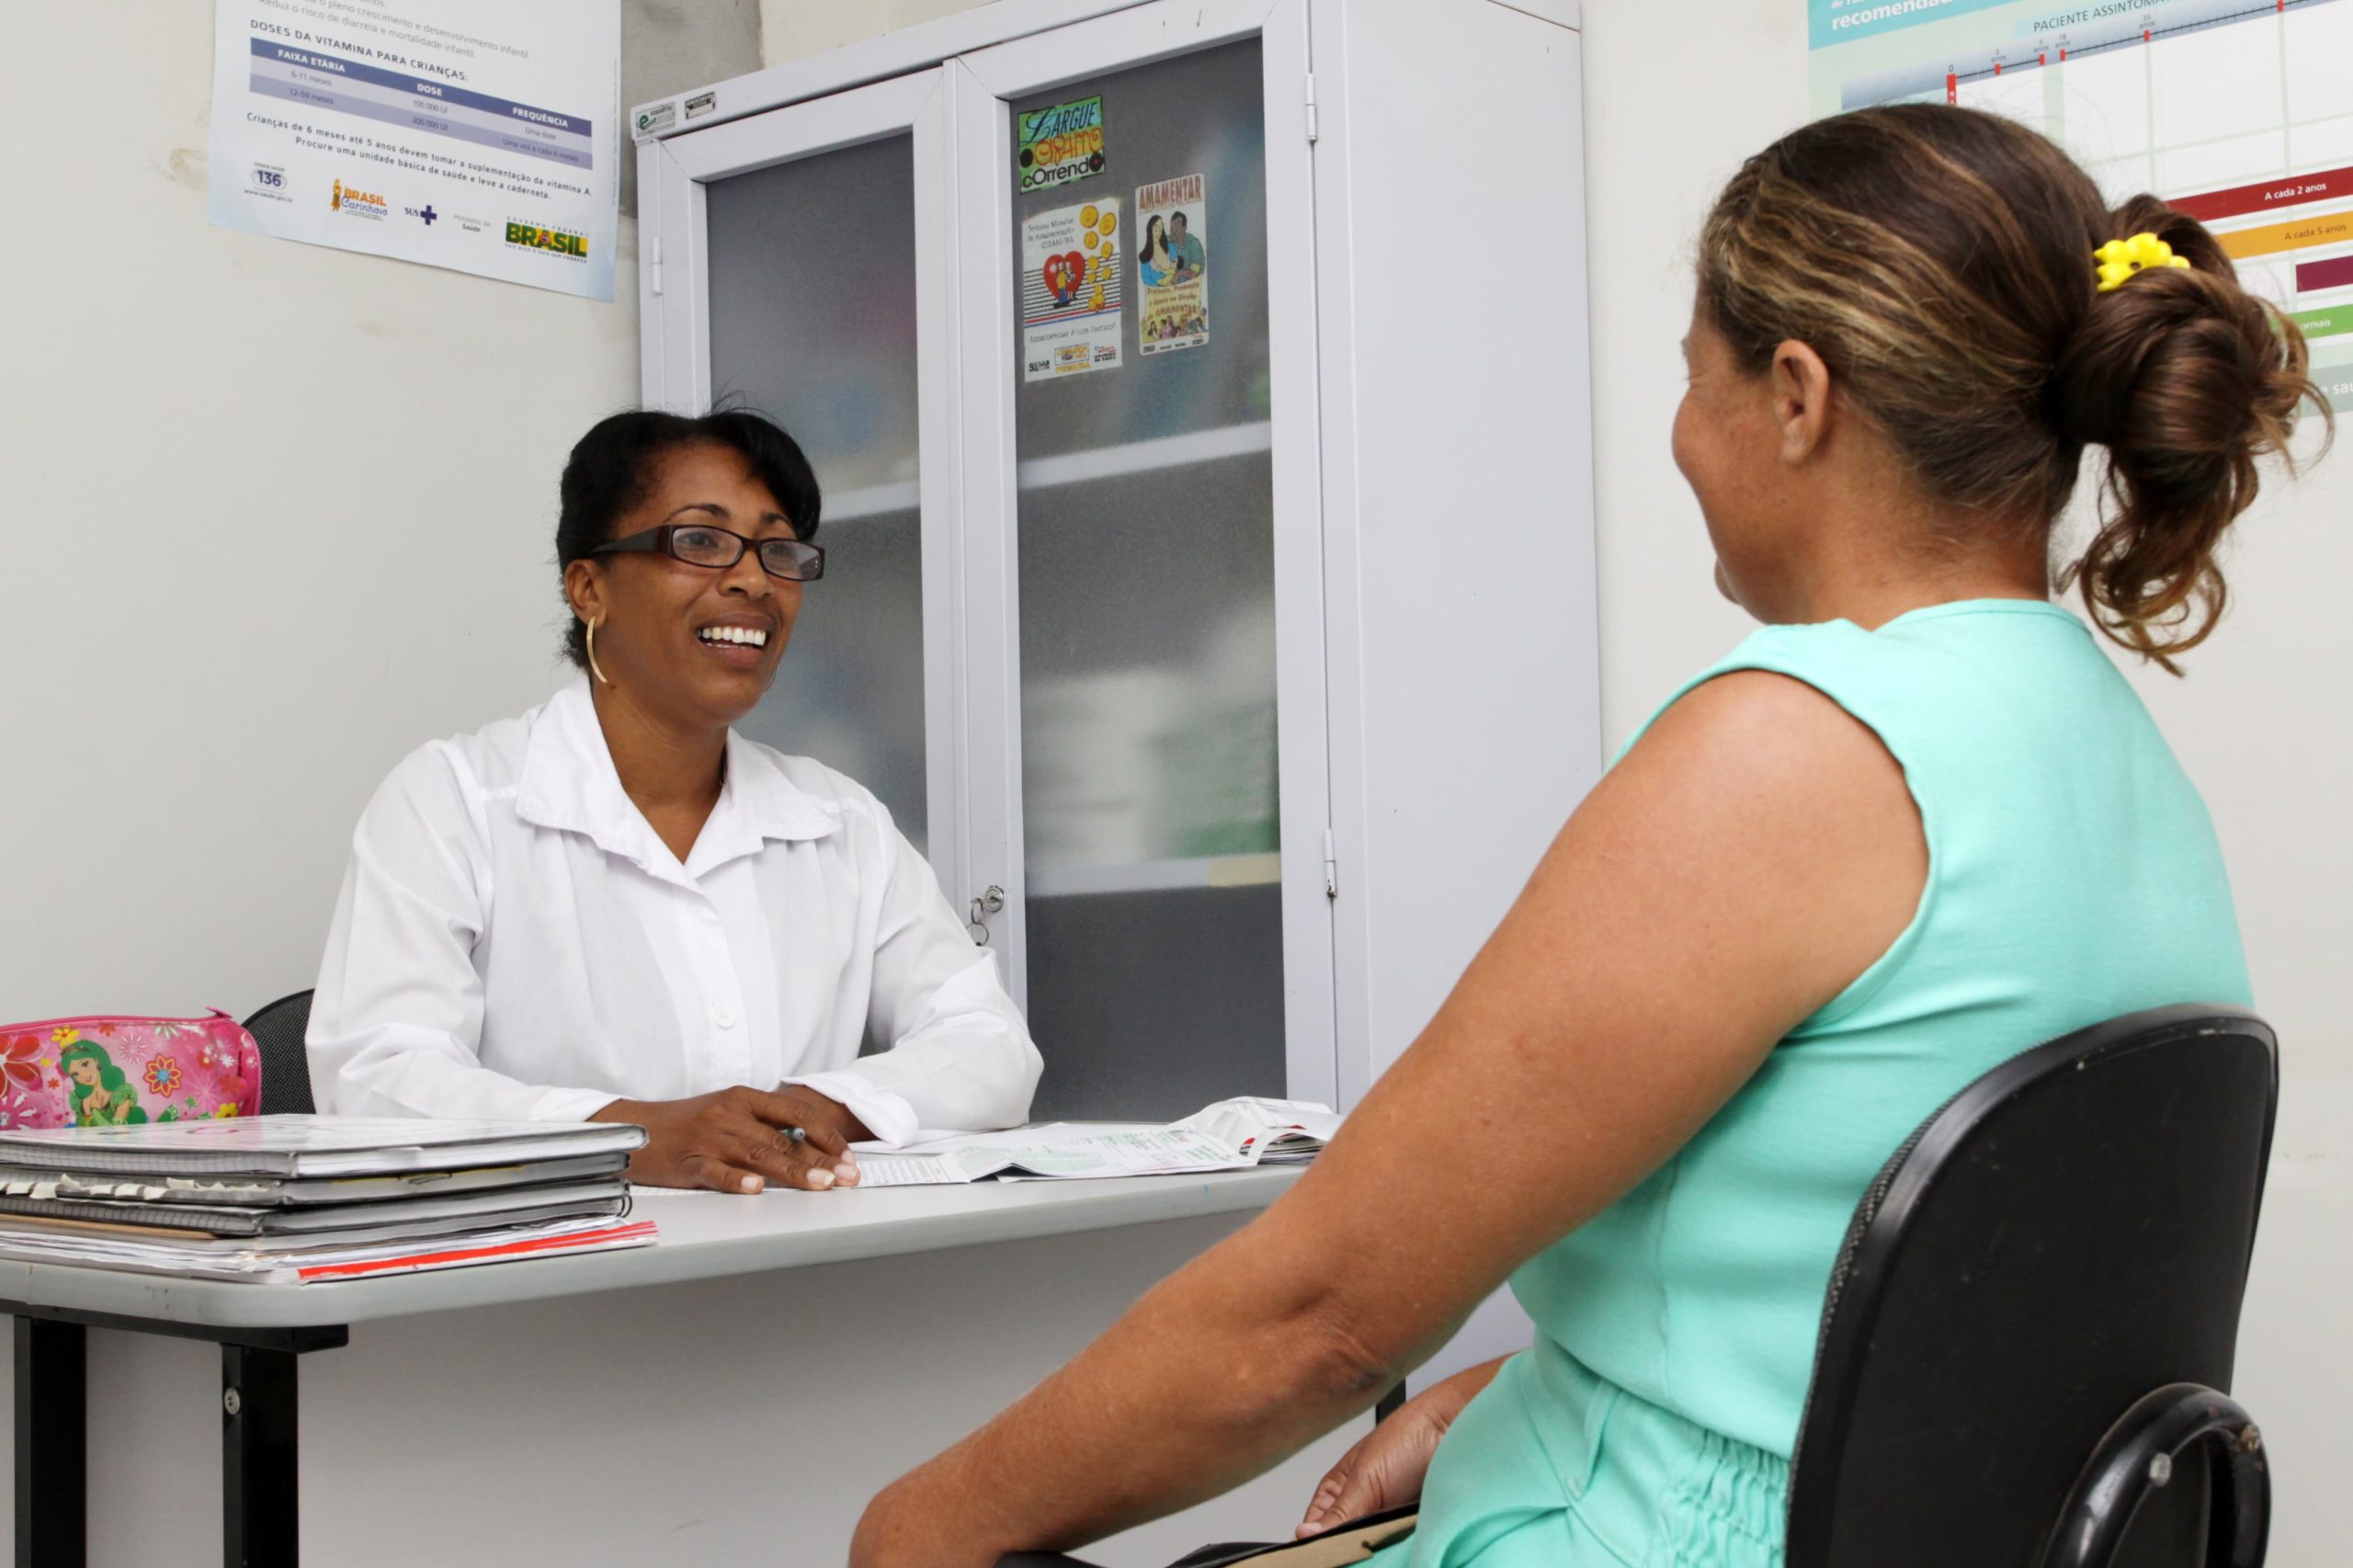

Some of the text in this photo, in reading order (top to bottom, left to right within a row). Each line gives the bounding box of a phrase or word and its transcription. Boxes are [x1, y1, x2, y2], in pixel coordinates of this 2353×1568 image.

[259, 0, 289, 11] Reduz
[301, 7, 324, 19] risco
[327, 13, 339, 23] de
[342, 17, 378, 33] diarreia
[389, 29, 442, 50] mortalidade
[328, 0, 355, 13] pleno
[358, 7, 413, 28] crescimento
[415, 23, 421, 31] e
[424, 24, 498, 51] desenvolvimento
[2033, 10, 2088, 33] PACIENTE
[250, 19, 469, 81] DOSES DA VITAMINA PARA CRIANÇAS:
[278, 50, 346, 73] FAIXA ETÁRIA
[290, 71, 331, 86] 6-11 meses
[417, 83, 443, 96] DOSE
[311, 94, 335, 105] meses
[513, 107, 568, 128] FREQUÊNCIA
[1019, 102, 1097, 145] LARGUE
[503, 138, 518, 147] Uma
[525, 127, 556, 140] Uma dose
[246, 112, 289, 129] Crianças
[291, 123, 303, 132] de
[307, 125, 313, 134] 6
[316, 129, 346, 141] meses
[349, 133, 364, 145] até
[368, 138, 372, 146] 5
[375, 142, 396, 152] anos
[399, 146, 428, 159] devem
[431, 153, 456, 165] tomar
[468, 163, 531, 182] suplementação
[533, 176, 544, 186] da
[547, 178, 581, 193] vitamina
[296, 136, 333, 151] Procure
[336, 146, 357, 156] uma
[359, 151, 394, 165] unidade
[428, 165, 439, 175] de
[442, 169, 467, 181] saúde
[478, 176, 496, 187] leve
[507, 184, 551, 199] caderneta.
[257, 170, 281, 187] 136
[344, 188, 386, 206] BRASIL
[1140, 176, 1201, 210] AMAMENTAR
[2265, 183, 2327, 200] A cada 2 anos
[341, 197, 388, 216] Carinhoso
[404, 207, 419, 217] SUS
[461, 223, 480, 233] Saúde
[2284, 223, 2346, 241] A cada 5 anos
[506, 222, 587, 257] BRASIL
[2302, 319, 2331, 329] ormais
